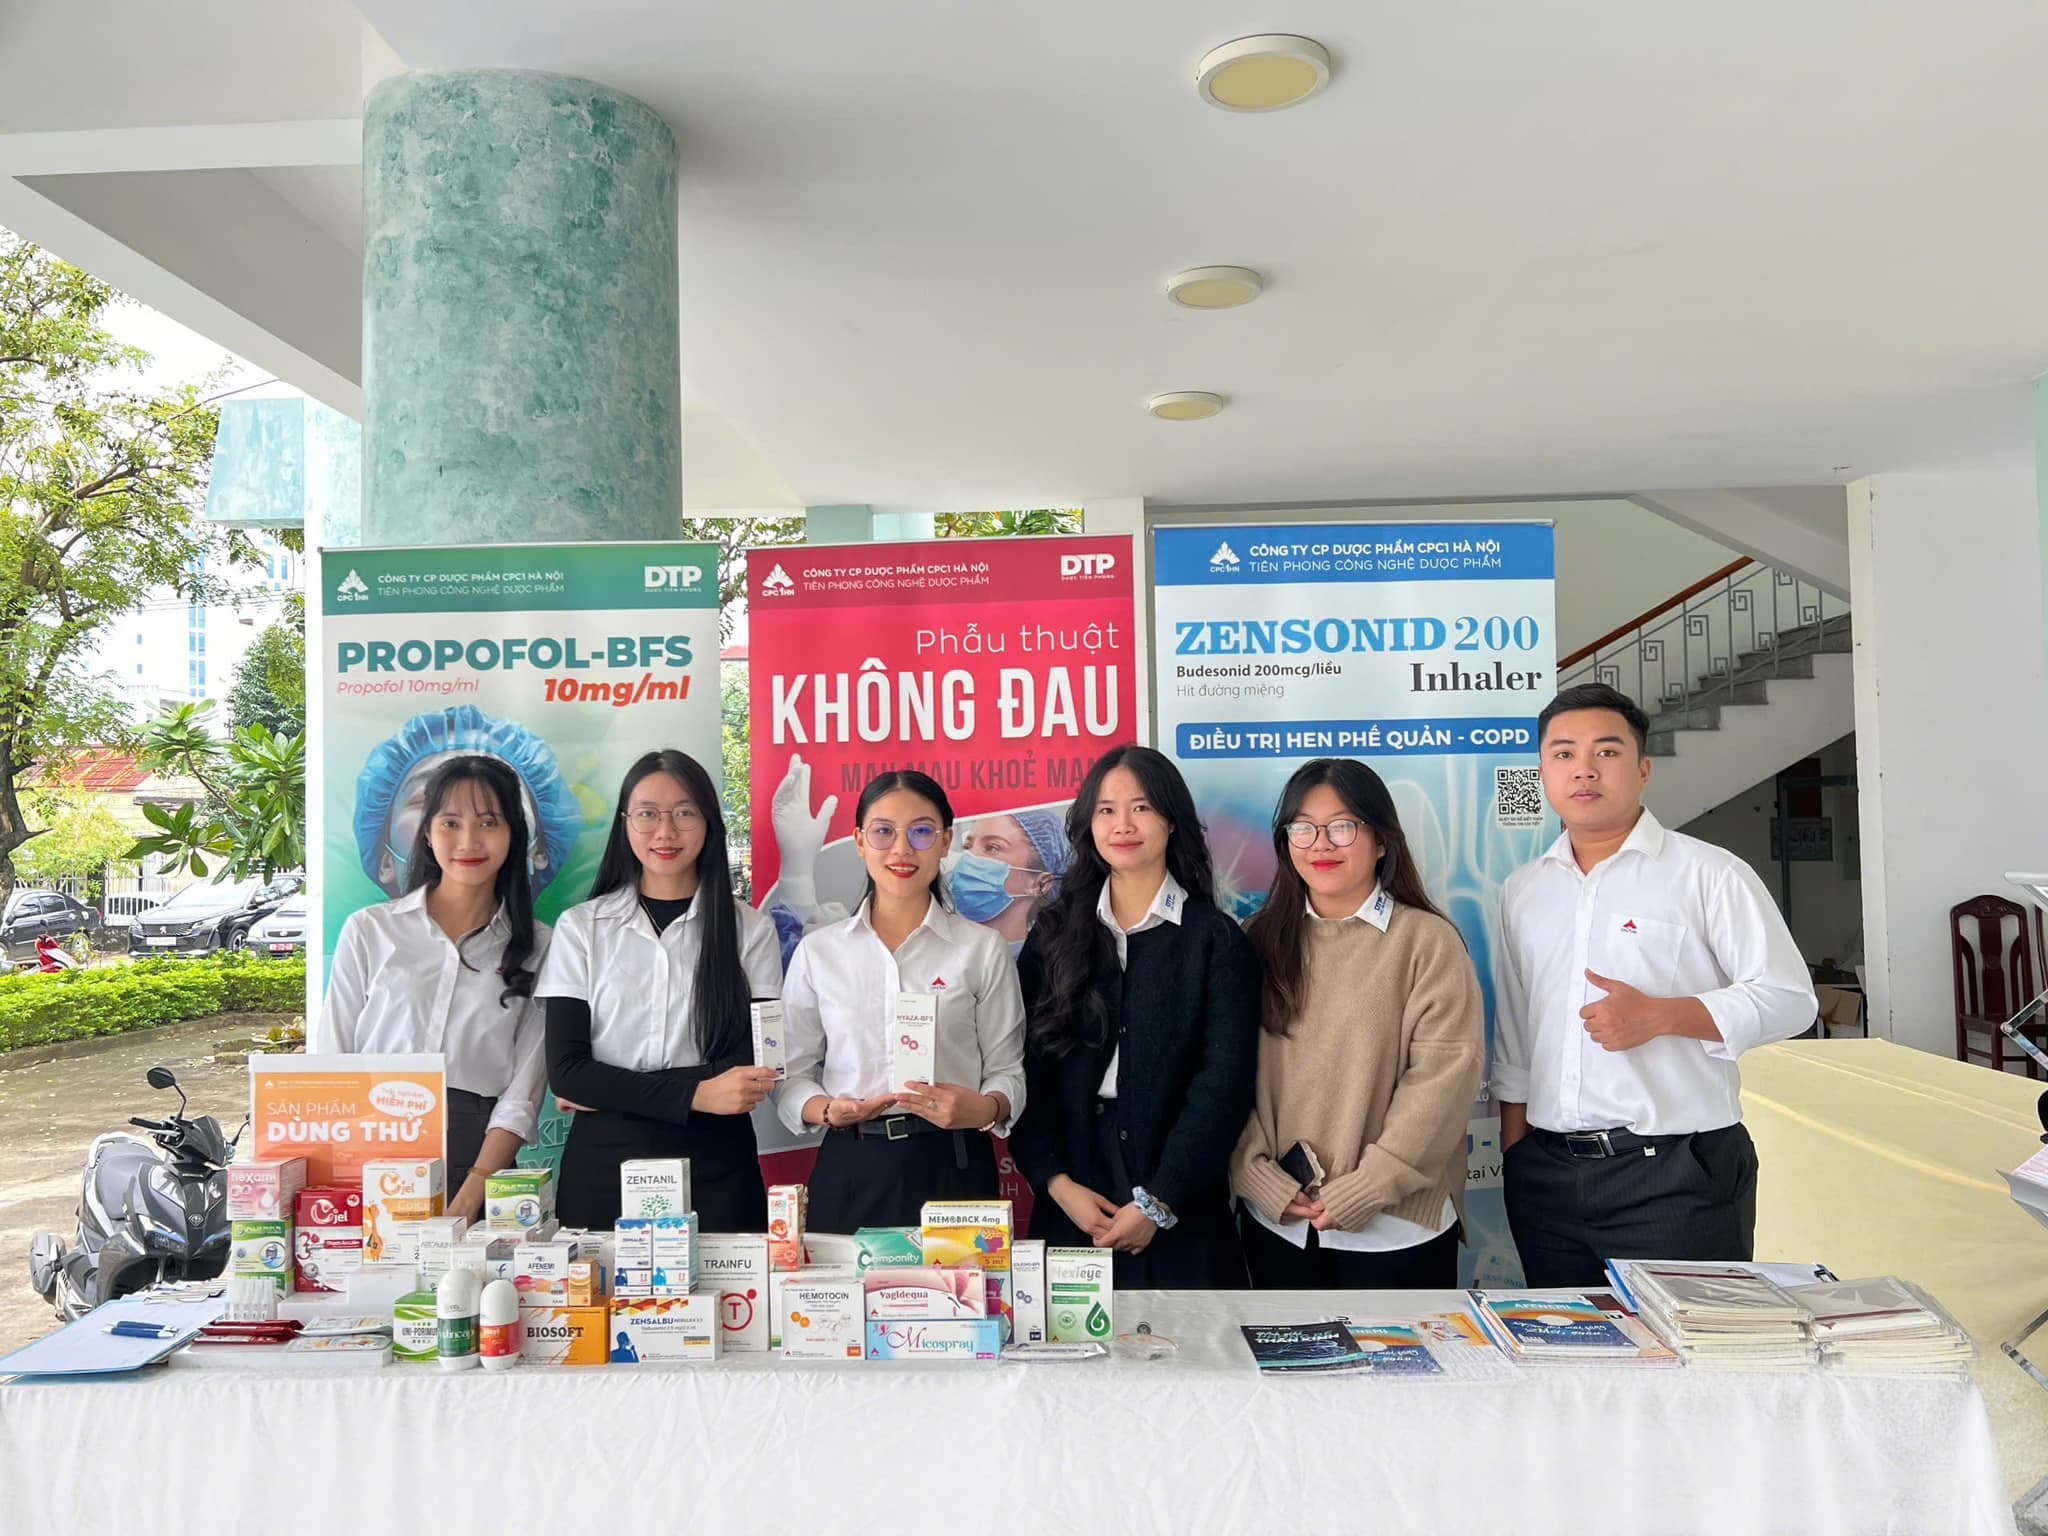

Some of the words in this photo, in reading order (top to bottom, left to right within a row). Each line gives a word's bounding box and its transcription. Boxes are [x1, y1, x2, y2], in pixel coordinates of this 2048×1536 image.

[1250, 543, 1288, 556] CÔNG
[1291, 545, 1308, 555] TY
[1311, 544, 1329, 555] CP
[1333, 543, 1371, 557] DƯỢC
[1375, 539, 1414, 554] PHẨM
[1417, 542, 1449, 553] CPC1
[1453, 540, 1472, 552] HÀ
[1476, 539, 1500, 555] NỘI
[803, 567, 832, 578] CÔNG
[834, 568, 846, 577] TY
[848, 567, 862, 576] CP
[927, 564, 951, 574] CPC1
[953, 562, 968, 573] HÀ
[970, 561, 989, 573] NỘI
[1061, 553, 1115, 576] DTP
[1249, 560, 1279, 572] TIÊN
[1283, 560, 1331, 571] PHONG
[1335, 558, 1373, 571] CÔNG
[377, 573, 407, 583] CÔNG
[408, 574, 421, 582] TY
[423, 574, 437, 582] CP
[502, 572, 526, 581] CPC1
[528, 571, 543, 580] HÀ
[644, 565, 702, 587] DTP
[803, 581, 825, 591] TIÊN
[827, 580, 863, 590] PHONG
[865, 578, 895, 588] CÔNG
[402, 585, 438, 596] PHONG
[440, 584, 470, 595] CÔNG
[915, 623, 1005, 655] Phẫu
[1019, 622, 1120, 660] thuật
[1175, 617, 1446, 655] ZENSONID
[1455, 615, 1539, 653] 200
[337, 635, 693, 673] PROPOFOL-BFS
[1176, 664, 1250, 678] Budesonid
[1254, 661, 1342, 678] 200mcg/liều
[1409, 661, 1543, 693] Inhaler
[337, 680, 403, 697] Propofol
[408, 677, 479, 695] 10mg/ml
[544, 673, 691, 707] 10mg/ml
[1177, 684, 1195, 697] Hít
[1199, 684, 1240, 699] đường
[1244, 684, 1284, 698] miệng
[771, 657, 975, 746] KHÔNG
[997, 664, 1119, 739] ĐAU
[1189, 727, 1241, 751] ĐIỀU
[1246, 731, 1281, 754] TRỊ
[1286, 730, 1334, 749] HEN
[1338, 723, 1381, 748] PHẾ
[1386, 724, 1451, 750] QUẢN
[1470, 727, 1530, 746] COPD
[971, 749, 1038, 789] KHOẺ
[266, 1098, 300, 1116] SẢN
[306, 1097, 356, 1116] PHẨM
[267, 1115, 350, 1143] DÙNG
[359, 1113, 423, 1143] THỬ
[626, 1175, 677, 1185] ZENTANIL
[1467, 1165, 1486, 1182] tại
[982, 1215, 1000, 1224] 4mg
[704, 1259, 752, 1269] TRAINFU
[799, 1292, 850, 1300] HEMOTOCIN
[728, 1302, 741, 1320] T
[630, 1317, 674, 1326] ZENSALBU
[527, 1327, 584, 1338] BIOSOFT
[886, 1326, 974, 1352] Micospray
